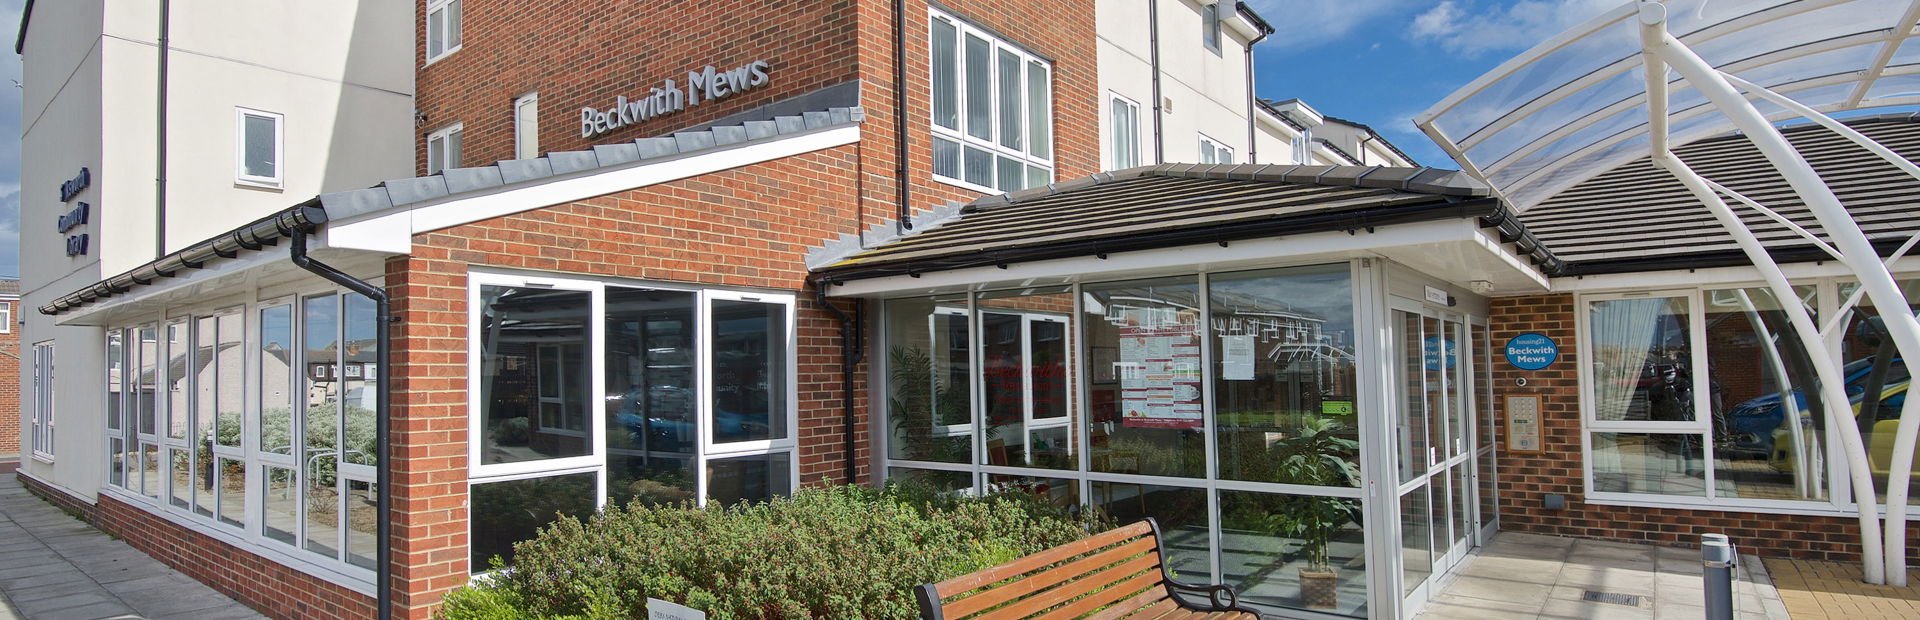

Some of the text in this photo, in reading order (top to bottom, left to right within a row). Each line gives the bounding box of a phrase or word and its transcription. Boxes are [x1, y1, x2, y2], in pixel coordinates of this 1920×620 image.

[582, 60, 769, 138] Beckwith Mews
[1508, 347, 1555, 355] Beckwith
[1517, 355, 1546, 363] Mews
